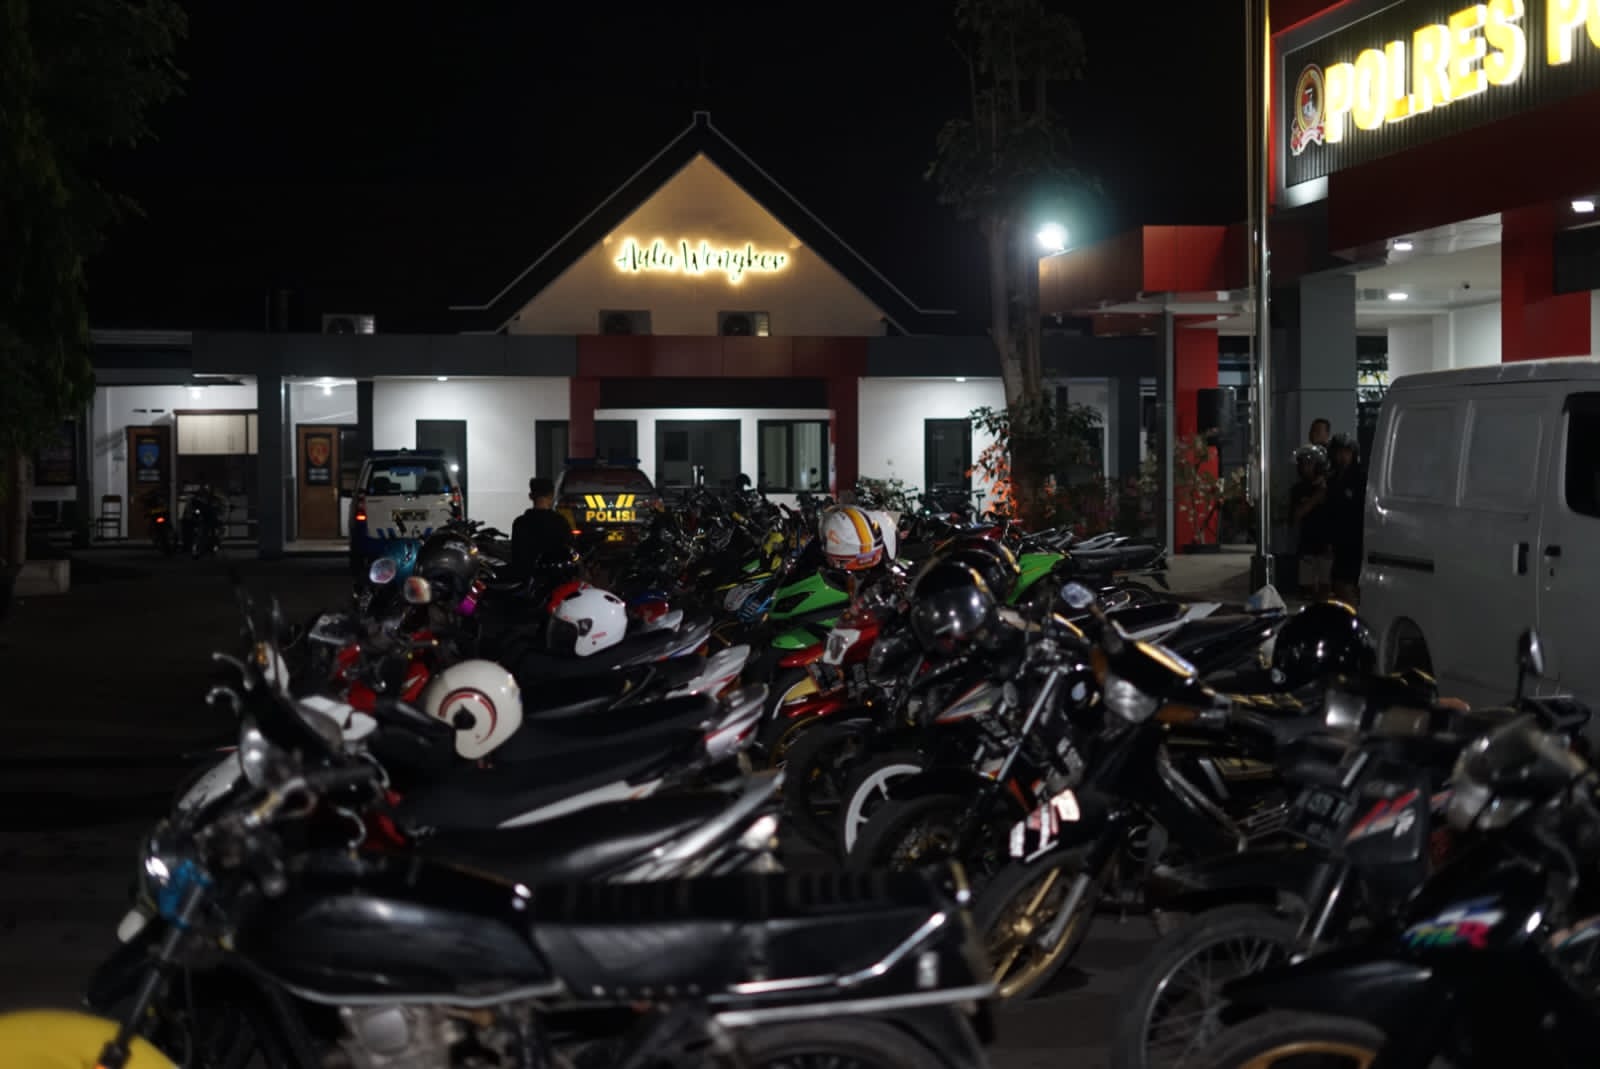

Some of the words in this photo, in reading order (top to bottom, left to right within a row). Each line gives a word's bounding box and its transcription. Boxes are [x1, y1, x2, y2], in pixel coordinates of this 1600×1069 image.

[1324, 0, 1526, 143] POLRES
[1546, 0, 1600, 65] P
[617, 239, 676, 271] Aula
[585, 510, 636, 523] POLISI
